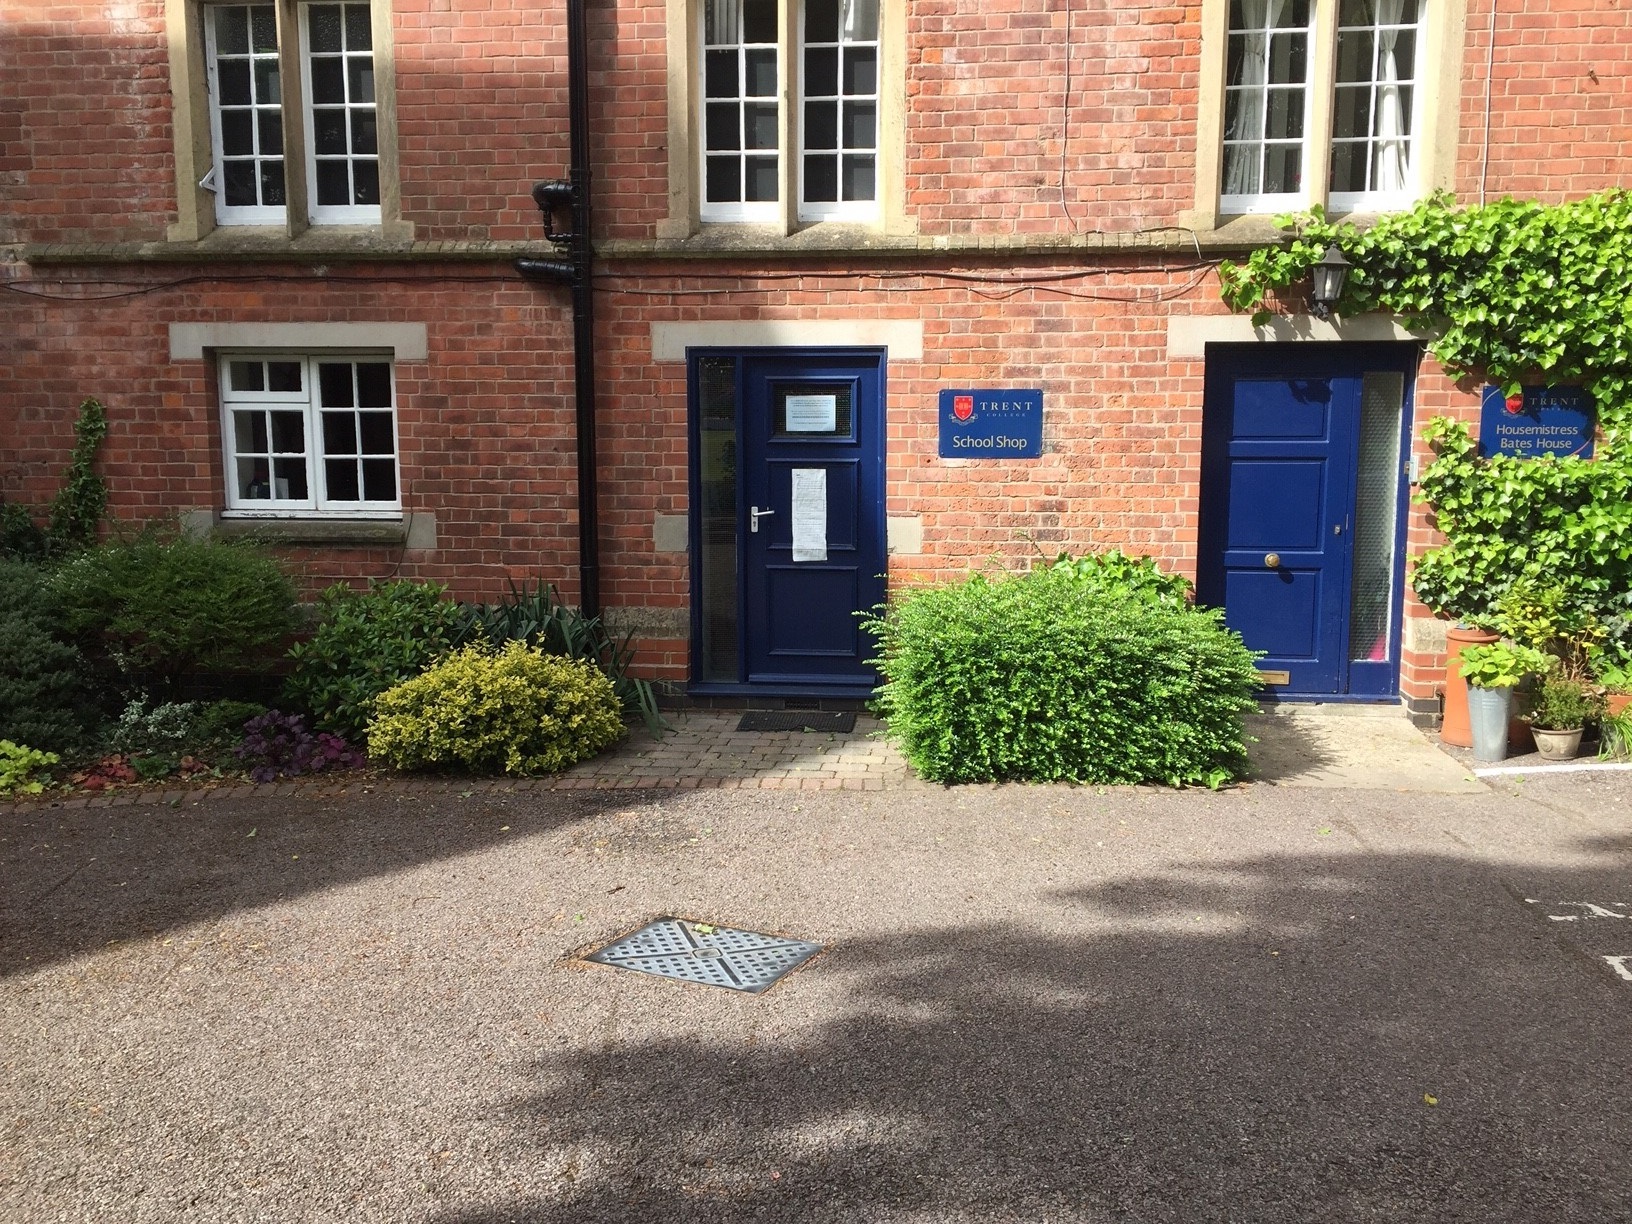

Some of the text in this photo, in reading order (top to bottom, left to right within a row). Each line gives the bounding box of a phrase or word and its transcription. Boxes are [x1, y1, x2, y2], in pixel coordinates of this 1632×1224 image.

[979, 401, 1033, 411] TRENT
[1529, 397, 1579, 406] TRENT
[1496, 424, 1578, 435] Housemistress
[953, 435, 1027, 450] School Shop
[1500, 438, 1572, 449] Bates House
